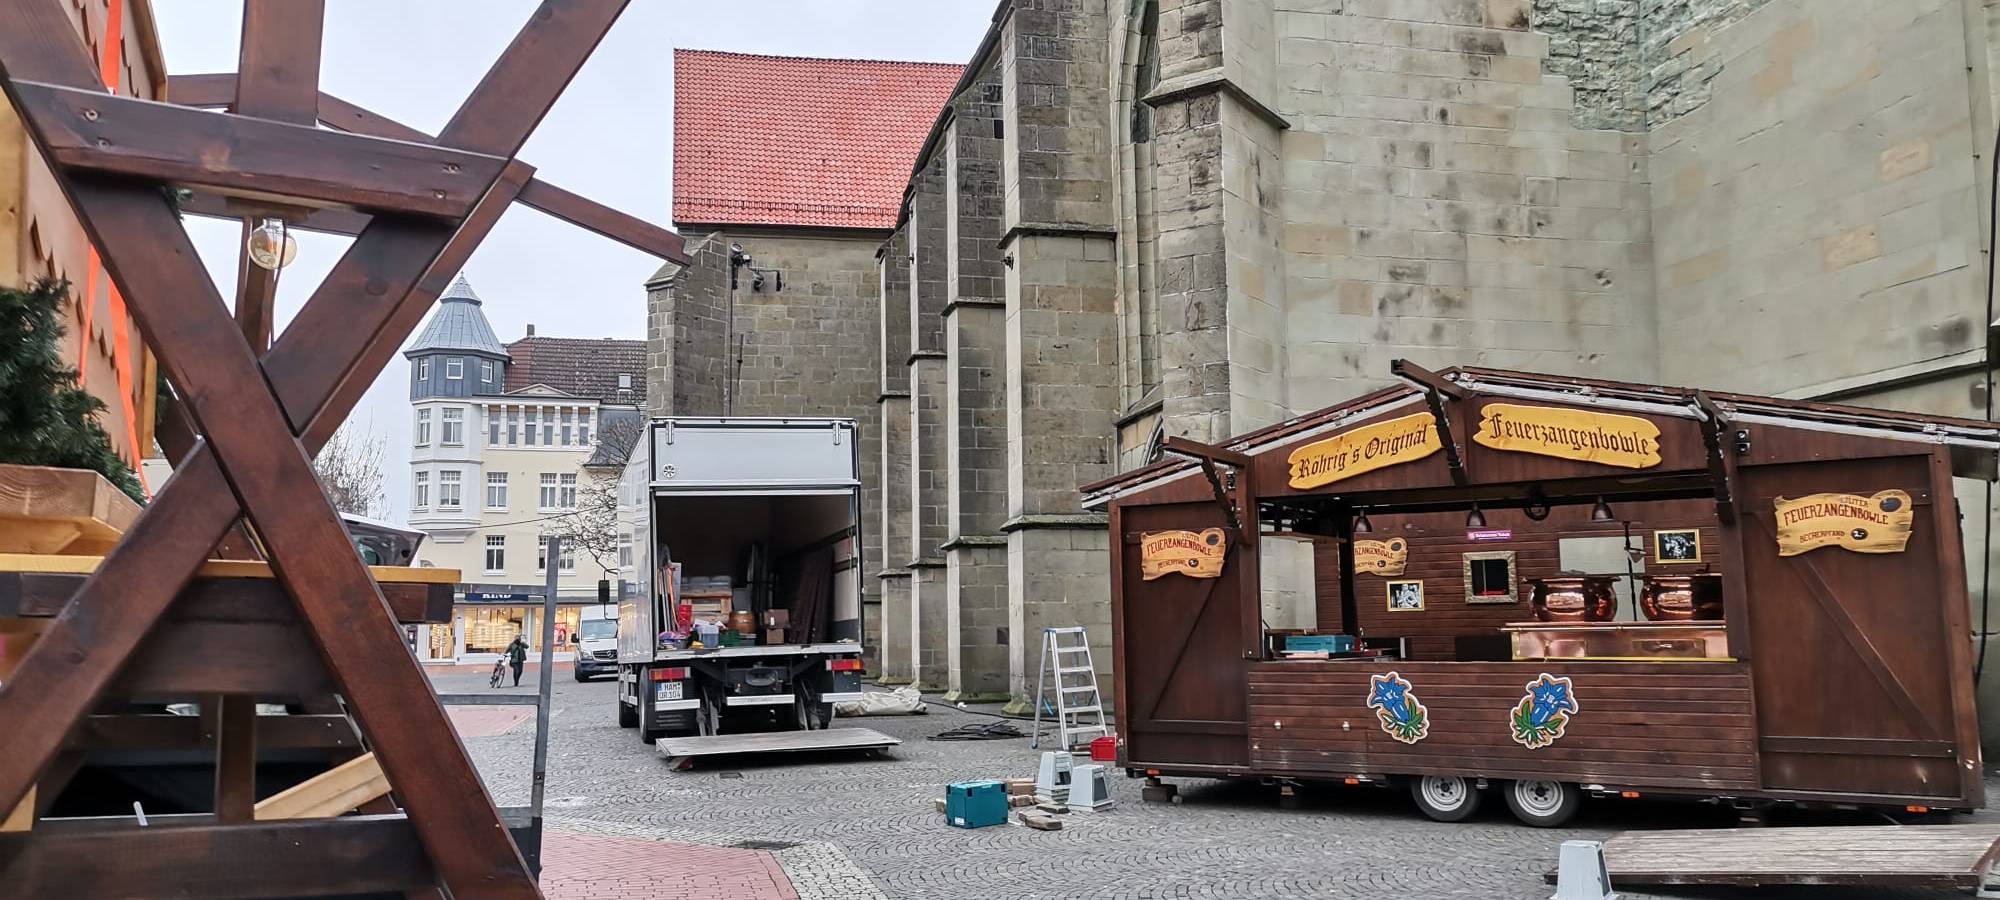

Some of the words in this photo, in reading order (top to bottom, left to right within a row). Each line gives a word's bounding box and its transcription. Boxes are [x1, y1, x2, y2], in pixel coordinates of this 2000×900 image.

[1364, 424, 1428, 460] Original
[1488, 412, 1649, 456] Feuerzangenbowle
[1783, 503, 1889, 526] FEUERZANGENBOWLE
[1146, 537, 1212, 557] FEUERZANGENBOWLE
